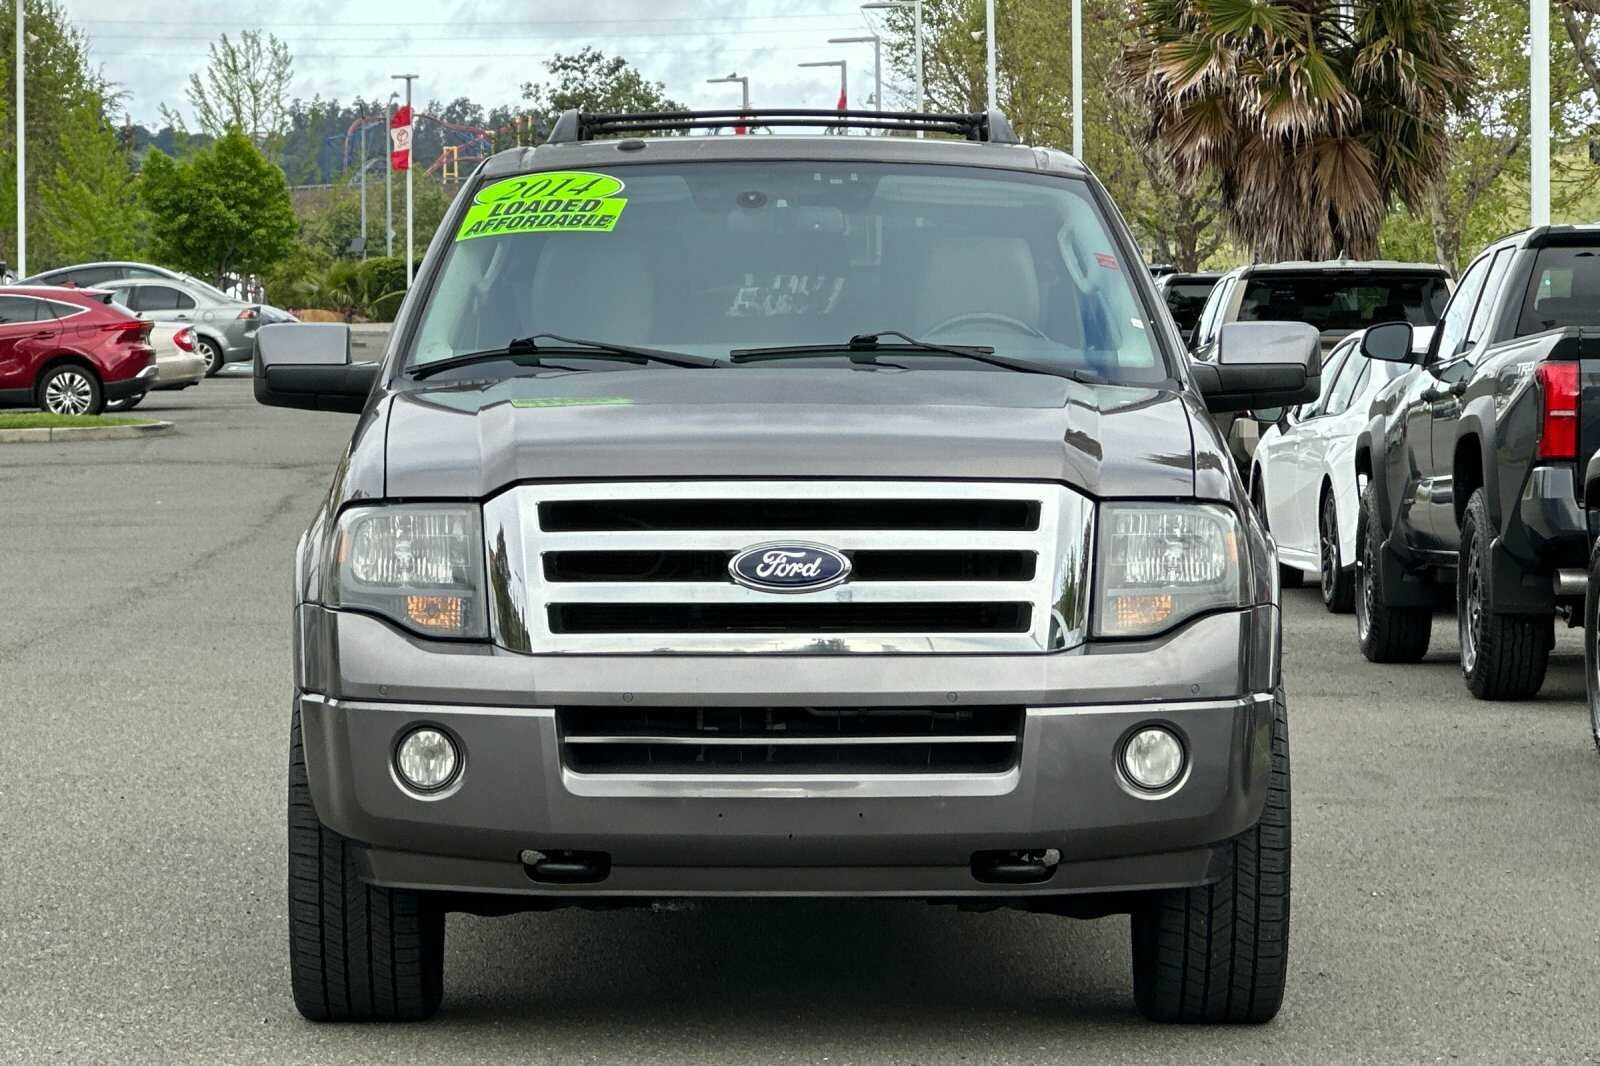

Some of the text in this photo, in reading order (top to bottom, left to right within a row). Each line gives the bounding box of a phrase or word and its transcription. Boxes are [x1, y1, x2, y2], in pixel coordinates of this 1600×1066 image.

[496, 178, 602, 200] 2014
[488, 199, 603, 217] LOADED
[464, 214, 617, 236] AFFORDABLE
[756, 551, 822, 577] Ford
